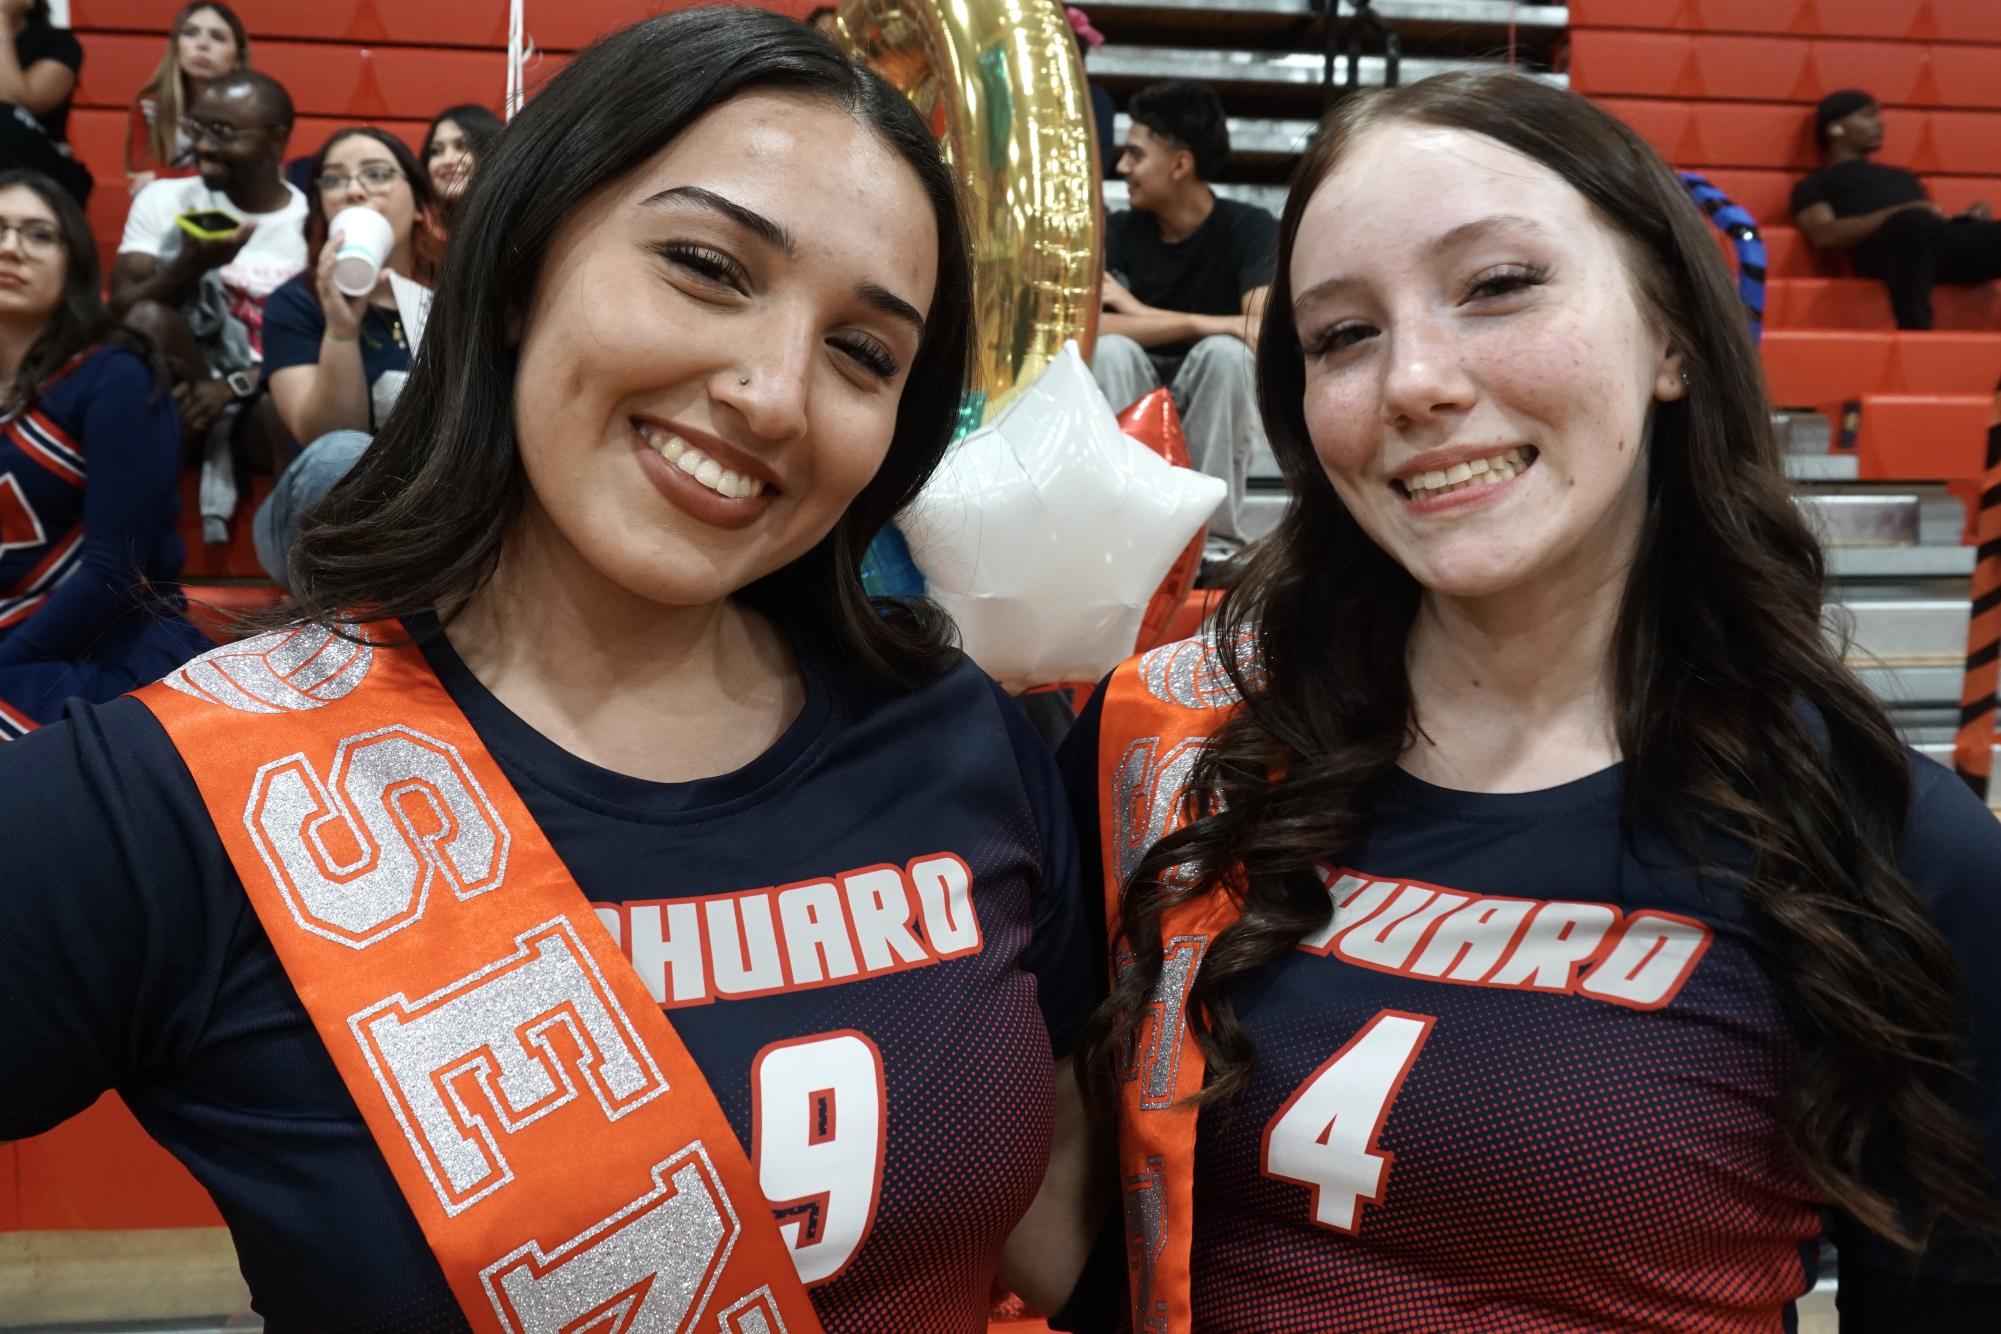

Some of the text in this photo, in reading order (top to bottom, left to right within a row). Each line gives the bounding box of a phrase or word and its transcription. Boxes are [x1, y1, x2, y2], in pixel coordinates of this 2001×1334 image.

[243, 724, 788, 1334] SEN
[592, 852, 984, 1009] HUARO
[1297, 860, 1713, 1011] HUARO
[751, 1029, 887, 1287] 9
[1261, 1008, 1437, 1237] 4
